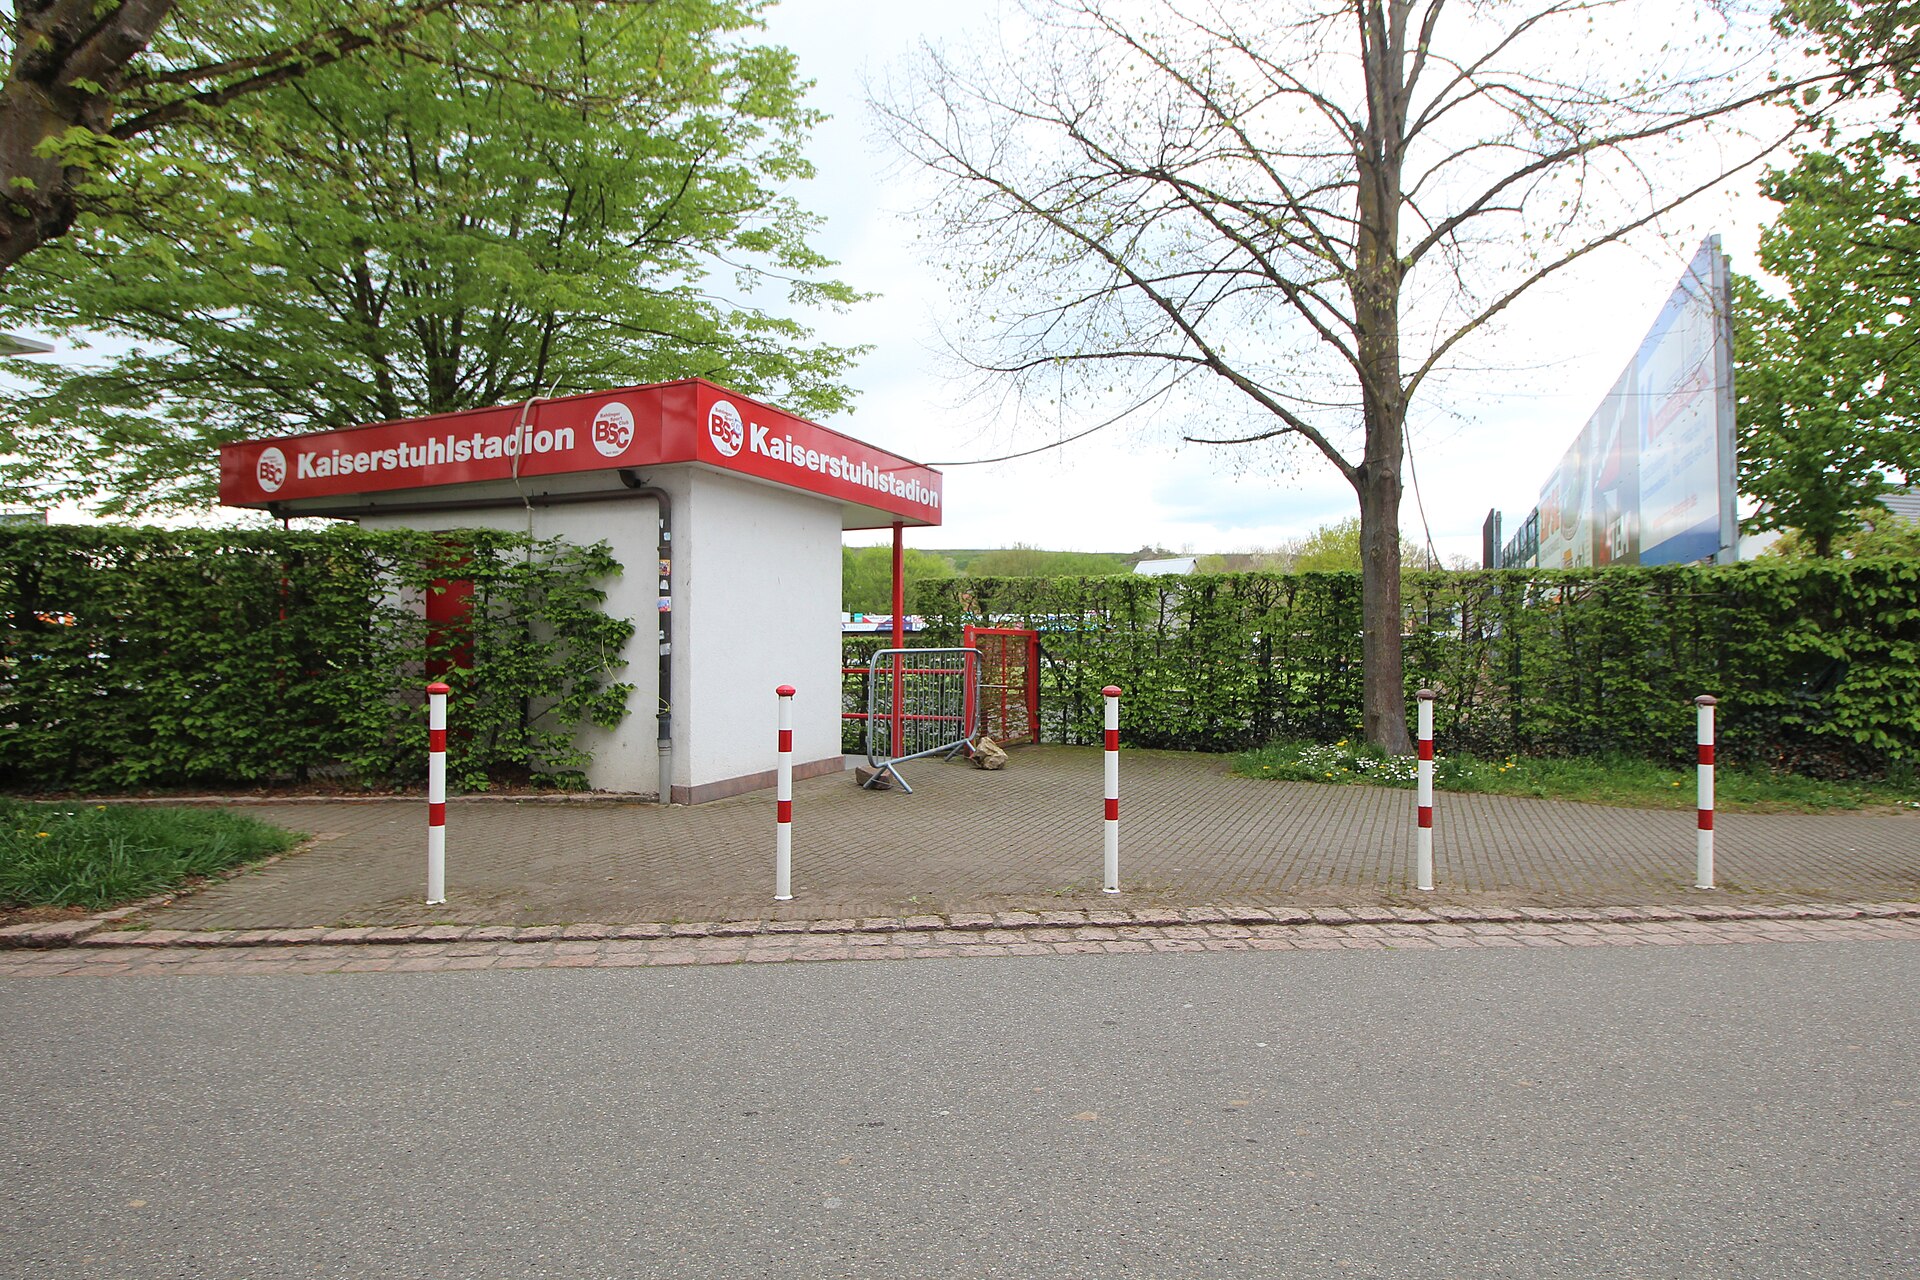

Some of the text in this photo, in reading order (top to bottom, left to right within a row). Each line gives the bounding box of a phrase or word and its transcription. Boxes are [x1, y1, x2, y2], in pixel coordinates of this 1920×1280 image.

[595, 420, 629, 449] BSC
[712, 413, 740, 451] BSC
[298, 425, 575, 480] Kaiserstuhlstadion
[750, 422, 939, 508] Kaiserstuhlstadion
[260, 462, 282, 486] BSC
